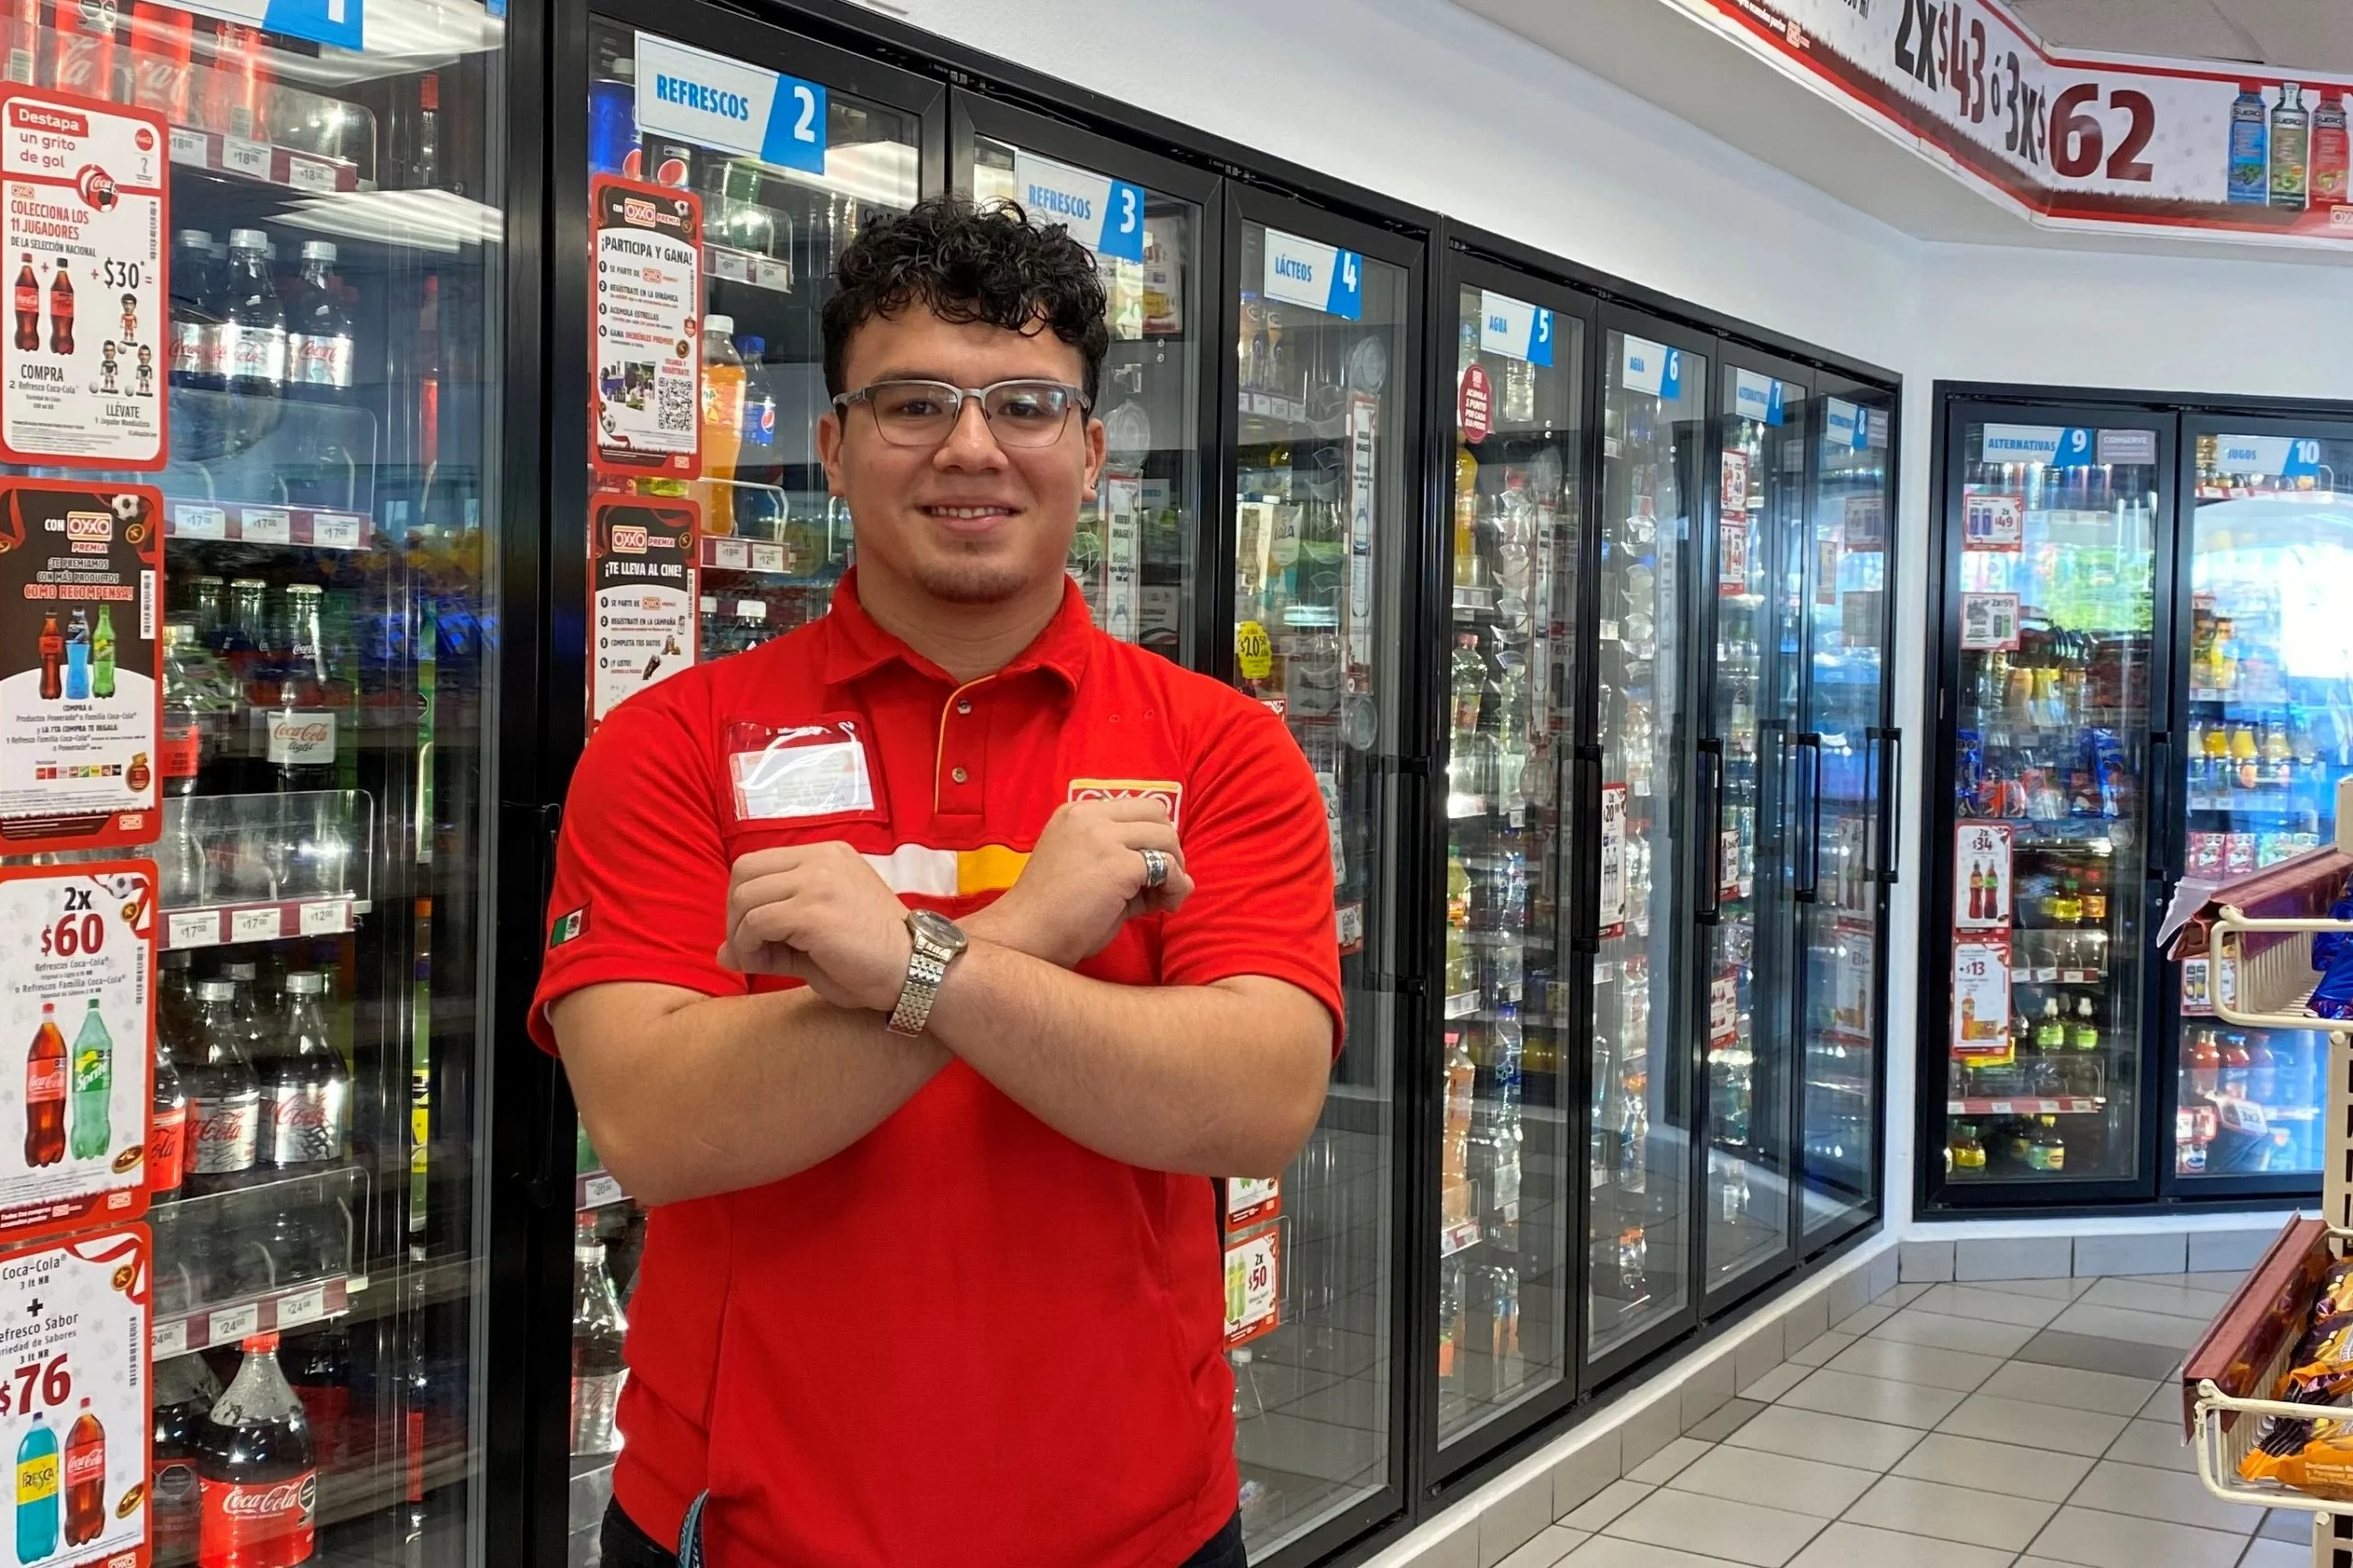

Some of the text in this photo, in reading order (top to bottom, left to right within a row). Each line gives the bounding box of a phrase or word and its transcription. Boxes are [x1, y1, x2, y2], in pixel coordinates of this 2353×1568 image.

[657, 74, 748, 121] REFRESCOS
[18, 108, 79, 131] Destapa
[794, 85, 815, 142] 2
[20, 133, 76, 151] un grito
[20, 150, 64, 168] de gol
[11, 199, 89, 224] COLECCIONA LOS
[1029, 184, 1091, 220] REFRESCOS
[1120, 189, 1135, 233] 3
[626, 204, 654, 222] OXXO
[11, 218, 79, 241] 11 JUGADORES
[11, 236, 97, 257] DE LA SELECCIÓN NACIONAL
[601, 236, 692, 266] ¡PARTICIPA Y GANA!
[1276, 254, 1312, 282] LÁCTEOS
[1343, 253, 1357, 292] 4
[1489, 315, 1507, 335] AGUA
[1539, 310, 1549, 343] 5
[21, 364, 64, 382] COMPRA
[1670, 351, 1678, 381] 6
[9, 381, 15, 389] 2
[18, 381, 45, 392] Refresco
[1775, 381, 1781, 410] 7
[107, 401, 140, 418] LLÉVATE
[1859, 410, 1865, 435] 8
[1988, 438, 2056, 452] ALTERNATIVAS
[2072, 429, 2086, 452] 9
[2227, 449, 2256, 460] JUGOS
[2296, 441, 2319, 463] 10
[45, 519, 109, 535] CON OXXO
[74, 543, 107, 551] PREMIA
[614, 531, 675, 548] OXXO PREMIA
[63, 558, 108, 570] PREMIAMOS
[606, 562, 681, 577] ¡TE LLEVA AL CINE!
[37, 570, 119, 583] CON MÁS PRODUCTOS
[25, 585, 57, 599] COMO
[1972, 837, 1993, 850] $34
[64, 887, 92, 911] 2x
[40, 914, 104, 957] $60
[35, 961, 67, 971] Refrescos
[22, 983, 56, 993] Refrescos
[3, 1257, 60, 1280] Coca-Cola
[20, 1281, 25, 1290] 3
[0, 1313, 79, 1343] efresco Sabor
[32, 1337, 41, 1347] de
[46, 1330, 77, 1345] Sabores
[20, 1355, 25, 1364] 3
[0, 1353, 71, 1416] $76
[222, 1482, 299, 1514] Coca-Cola
